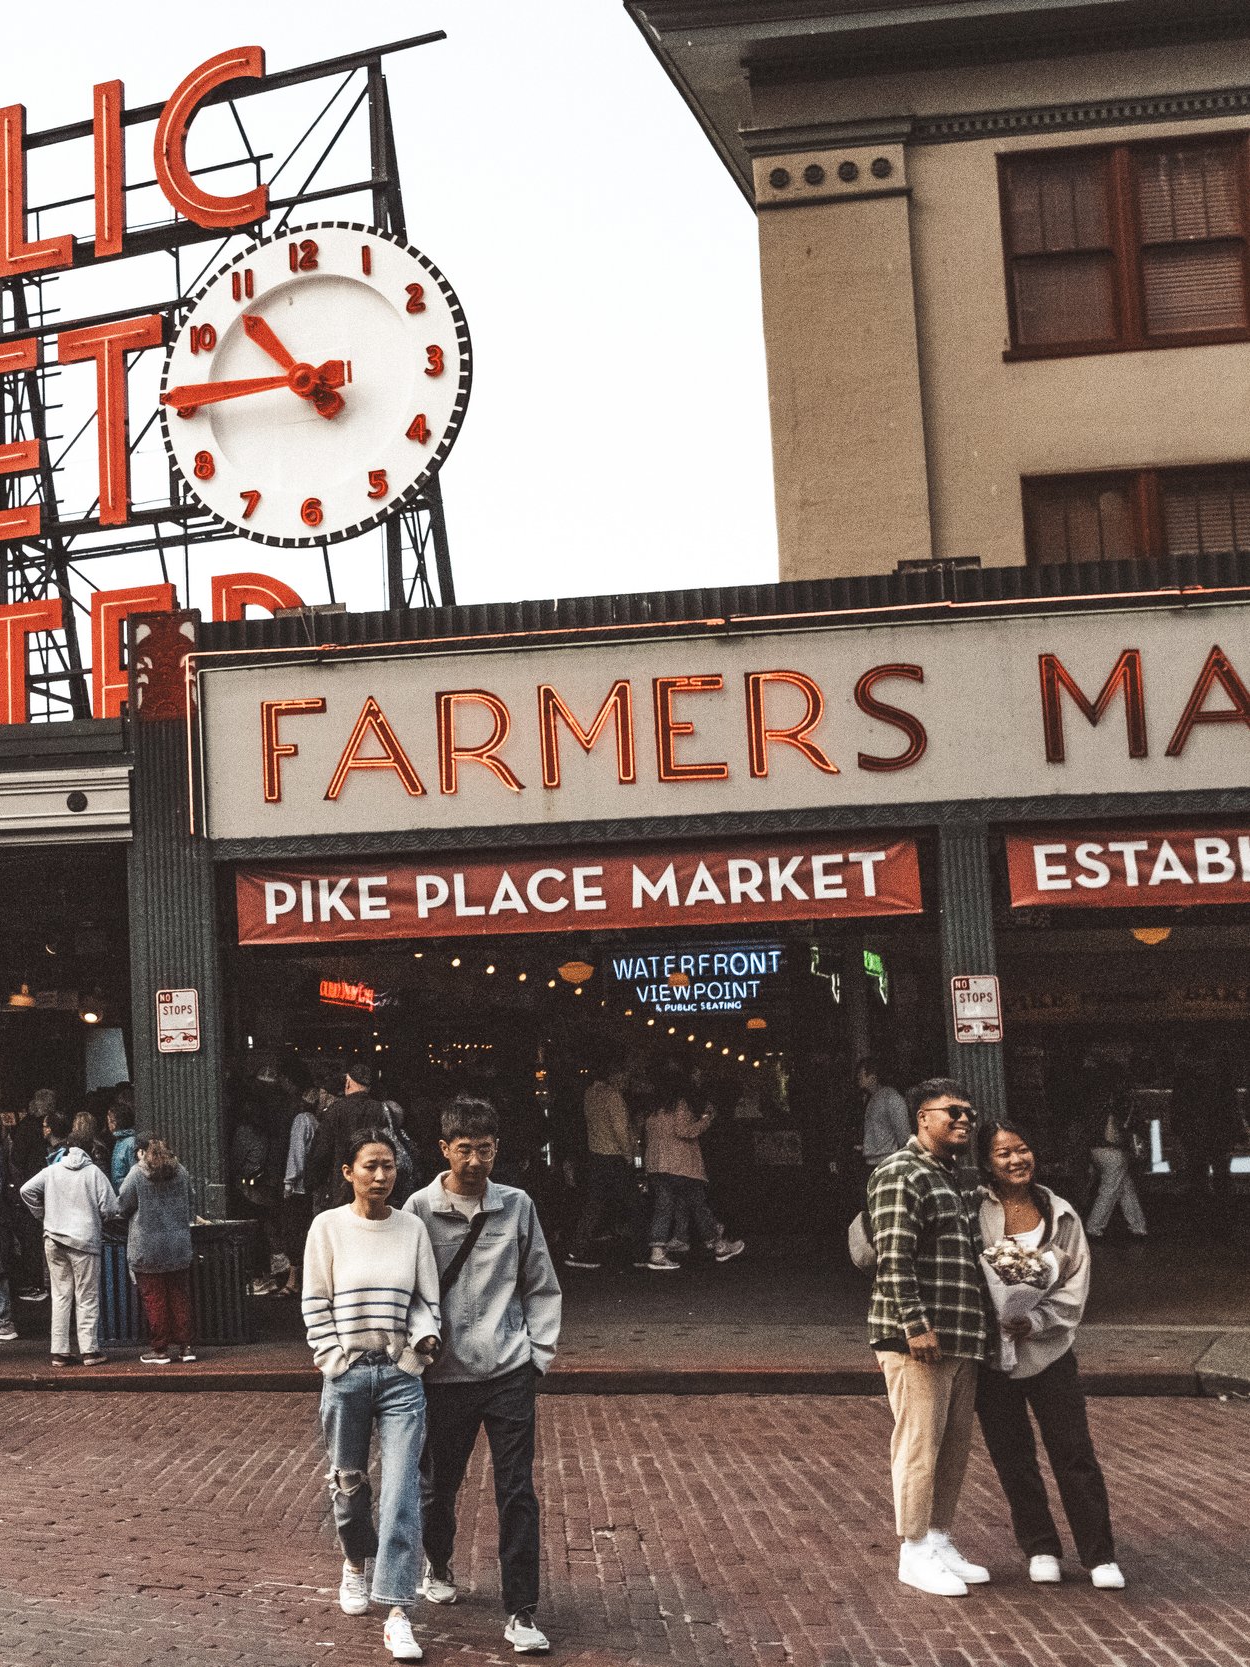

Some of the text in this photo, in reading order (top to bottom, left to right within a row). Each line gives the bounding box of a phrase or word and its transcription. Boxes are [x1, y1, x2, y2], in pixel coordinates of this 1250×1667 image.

[288, 239, 319, 272] 12
[361, 245, 372, 276] 1
[232, 268, 254, 301] 11
[405, 283, 426, 314] 2
[190, 323, 217, 355] 10
[424, 344, 444, 377] 3
[405, 413, 431, 445] 4
[193, 450, 215, 480] 8
[367, 469, 389, 499] 5
[239, 490, 261, 519] 7
[300, 498, 323, 527] 6
[259, 662, 928, 803] FARMERS
[264, 850, 887, 925] PIKE PLACE MARKET
[612, 950, 782, 981] WATERFRONT
[159, 993, 171, 1002] NO
[636, 980, 761, 1003] VIEWPOINT
[955, 979, 968, 989] NO
[959, 991, 993, 1004] STOPS
[163, 1004, 193, 1016] STOPS
[655, 1000, 742, 1012] & PUBLIC SEATING
